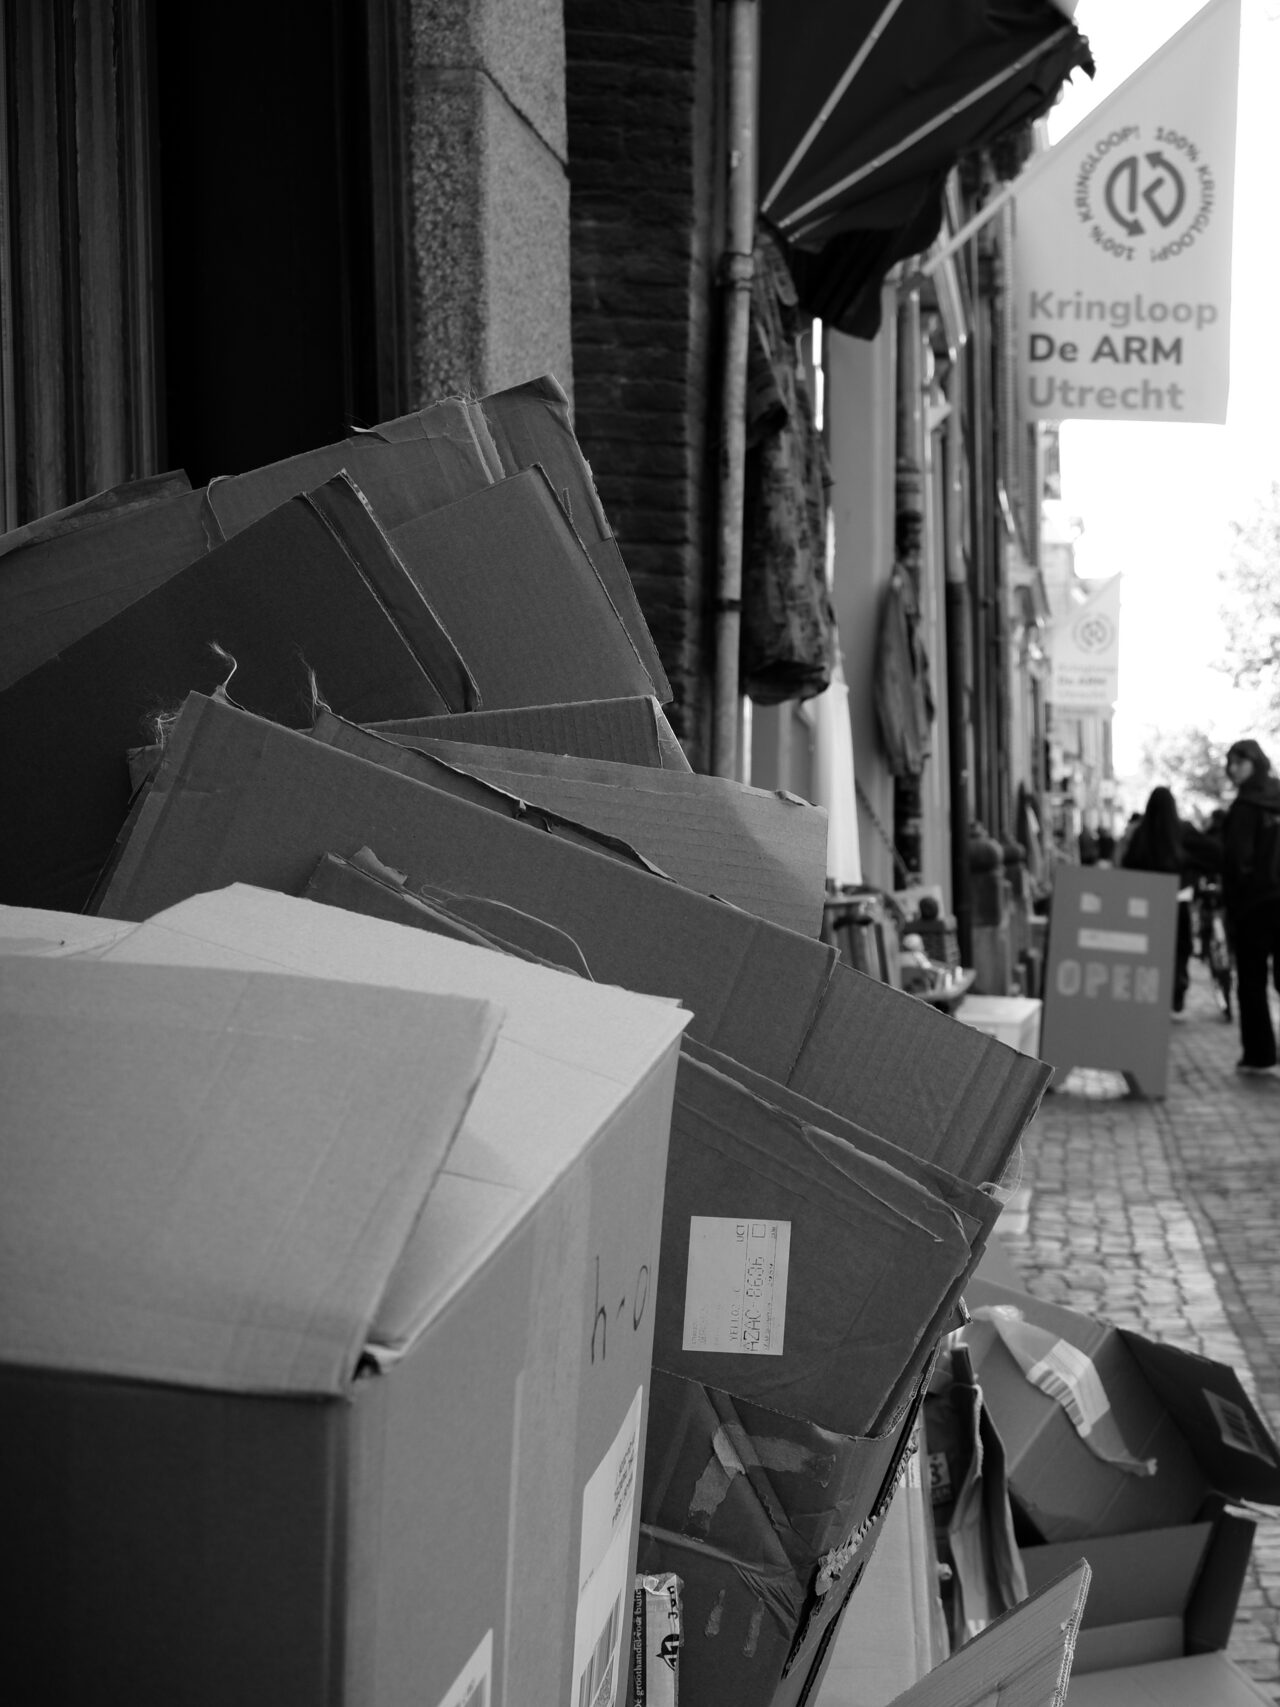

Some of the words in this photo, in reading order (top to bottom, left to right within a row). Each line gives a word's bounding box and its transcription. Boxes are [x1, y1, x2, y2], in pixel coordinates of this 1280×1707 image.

[1155, 126, 1199, 162] 100%
[1091, 225, 1134, 261] 100%
[1029, 291, 1218, 331] Kringloop
[1029, 334, 1078, 363] De
[1091, 335, 1183, 365] ARM
[1028, 376, 1184, 410] Utrecht
[1056, 959, 1159, 1003] OPEN
[634, 1639, 644, 1696] groothandel
